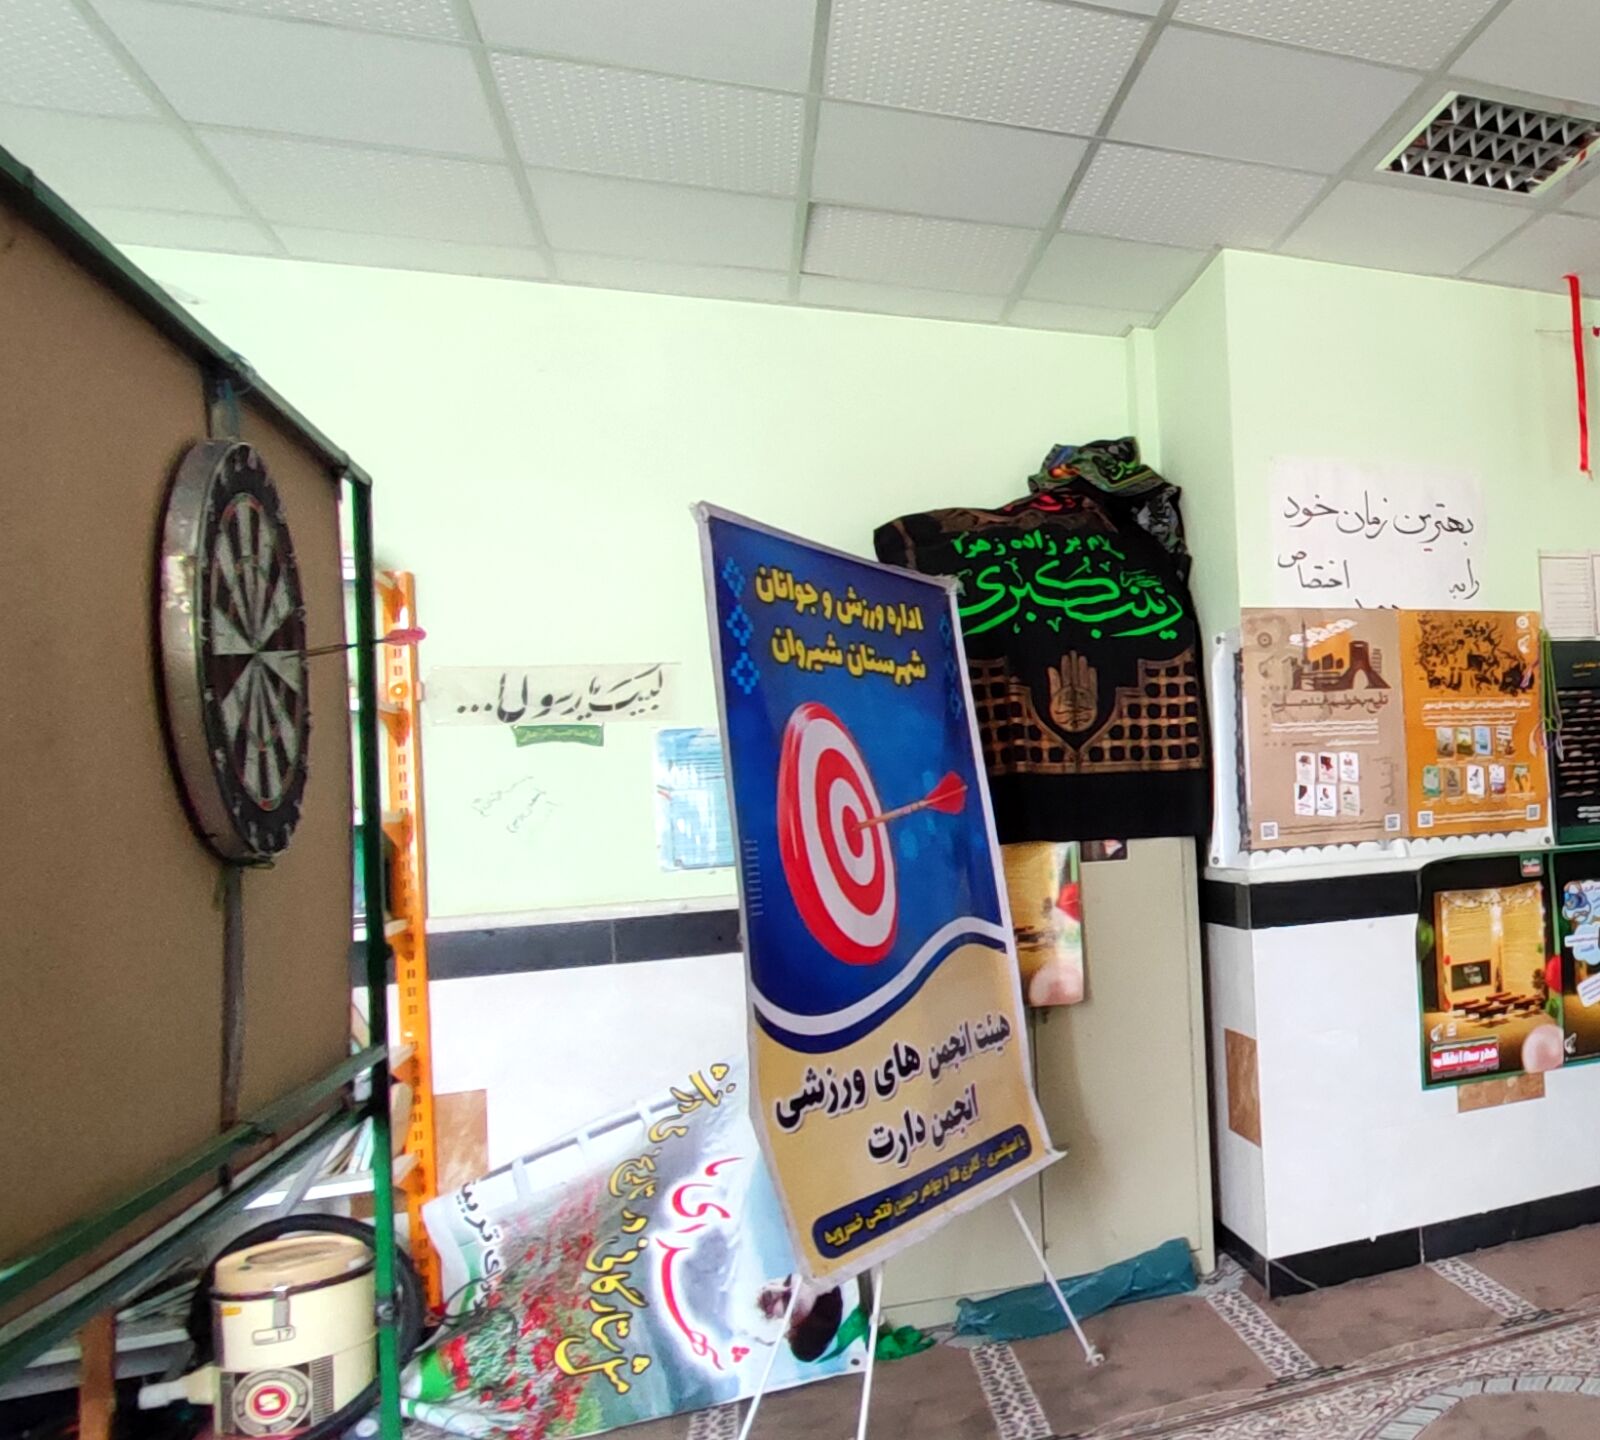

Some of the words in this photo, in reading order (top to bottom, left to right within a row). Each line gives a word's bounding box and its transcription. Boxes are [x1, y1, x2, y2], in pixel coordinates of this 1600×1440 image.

[1283, 494, 1340, 527] خود
[1336, 490, 1388, 538] زمان
[1393, 503, 1474, 552] بهترین
[755, 563, 820, 614] جوانان
[821, 592, 834, 619] و
[836, 588, 886, 631] ورزش
[889, 603, 924, 636] اداره
[770, 628, 844, 672] شیروان
[847, 644, 927, 687] شهرستان
[928, 1022, 971, 1079] انجمن
[974, 1013, 1011, 1053] هیئت
[874, 1041, 921, 1097] های
[776, 1066, 866, 1129] ورزشی
[932, 1084, 979, 1147] انجمن
[868, 1109, 926, 1163] دارت
[654, 1182, 751, 1371] شهدای
[704, 1156, 745, 1178] ما
